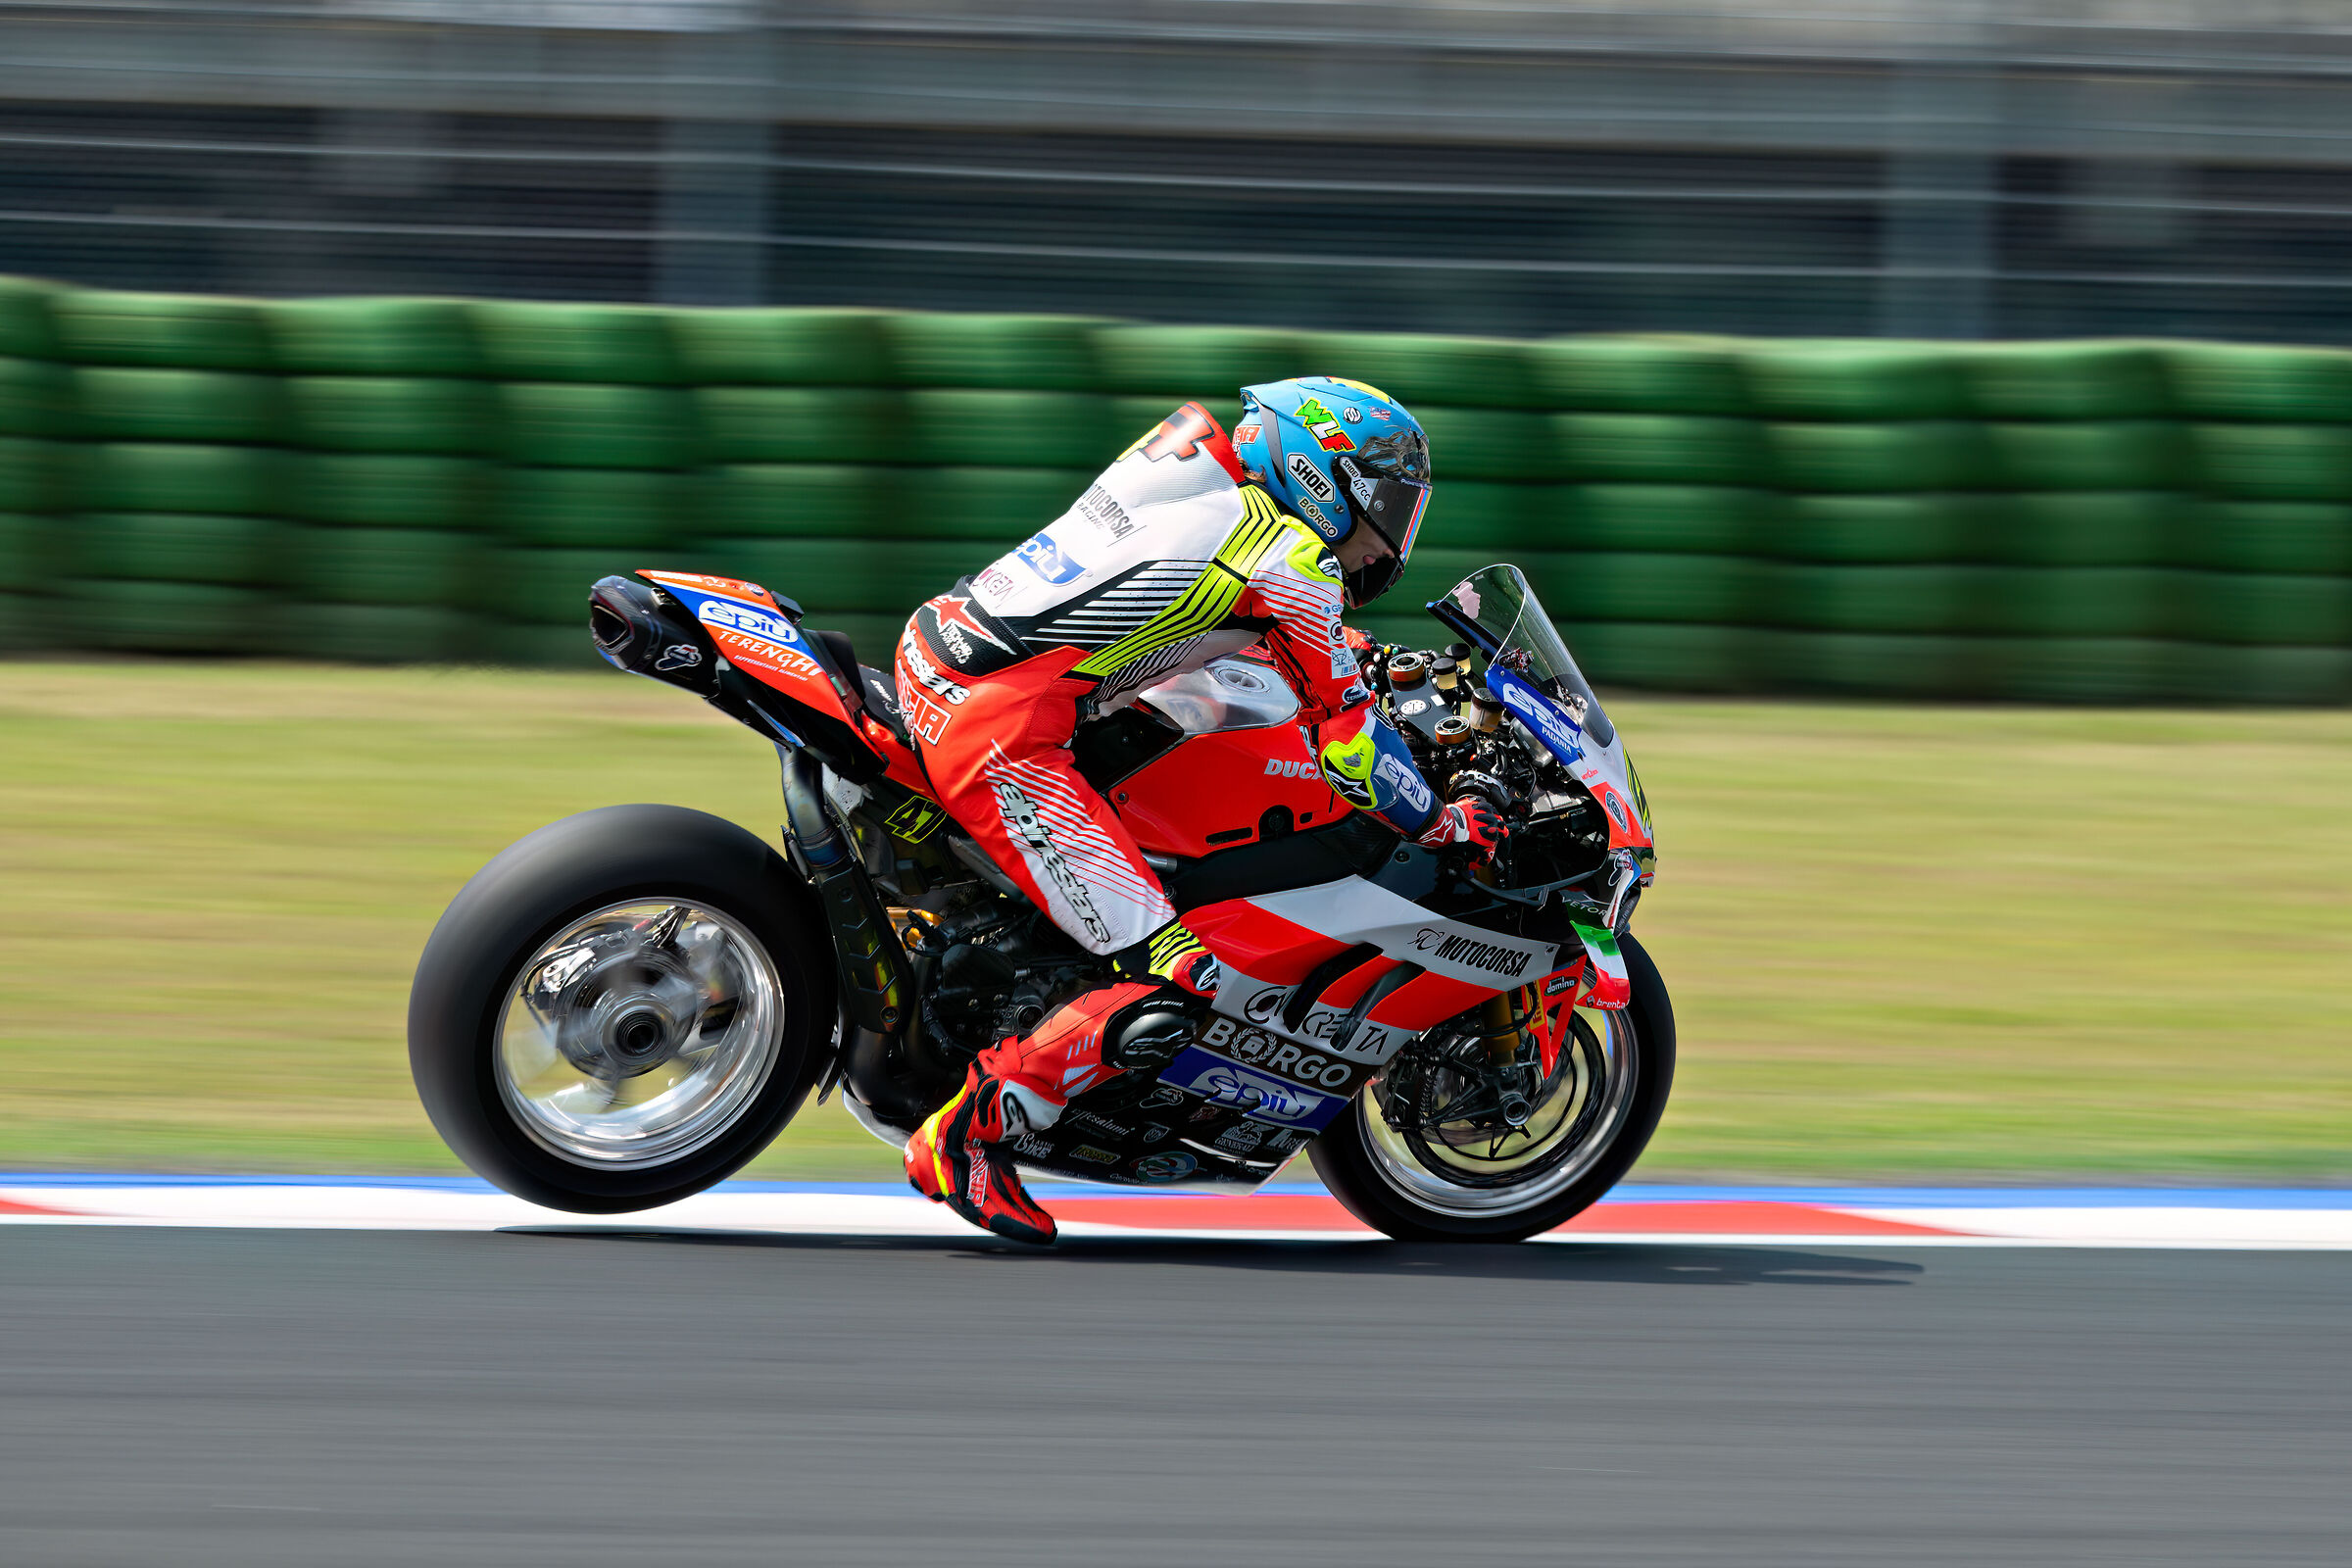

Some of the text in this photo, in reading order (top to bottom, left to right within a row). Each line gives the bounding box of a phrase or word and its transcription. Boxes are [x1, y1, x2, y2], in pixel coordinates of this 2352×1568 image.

[1295, 397, 1357, 454] WLF
[1292, 459, 1331, 499] SHOEI
[1342, 460, 1359, 478] SHOEI
[1298, 498, 1338, 537] BORGO
[1434, 934, 1533, 977] MOTOCORSA
[1201, 1017, 1352, 1087] BORGO
